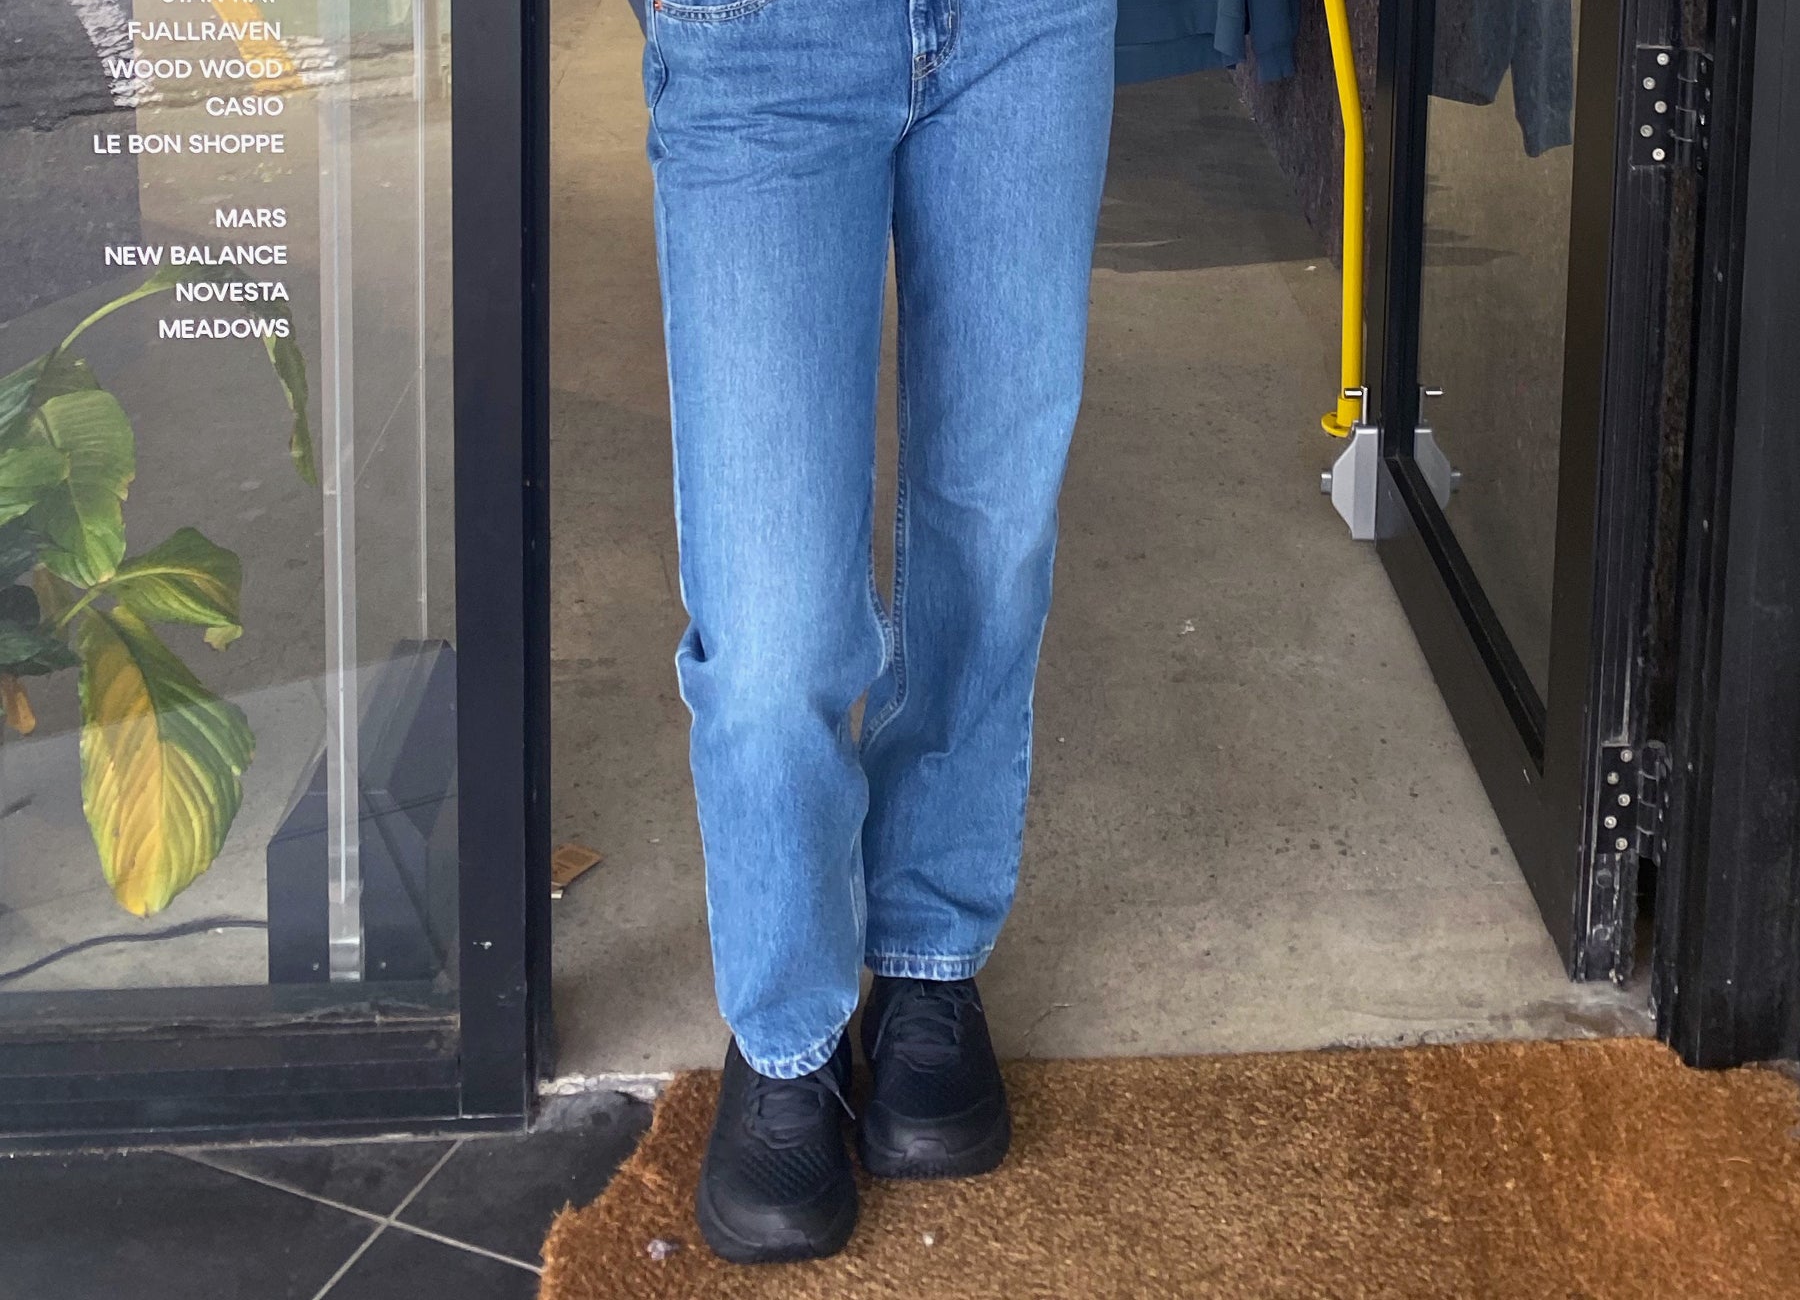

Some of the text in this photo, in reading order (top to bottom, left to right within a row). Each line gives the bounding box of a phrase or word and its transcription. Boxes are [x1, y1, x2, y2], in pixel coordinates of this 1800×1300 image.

[128, 21, 281, 41] FJALLRAVEN
[107, 59, 283, 79] WOOD WOOD
[205, 96, 284, 116] CASIO
[93, 134, 285, 154] LE BON SHOPPE
[215, 208, 287, 228] MARS
[104, 246, 288, 266] NEW BALANCE
[175, 282, 290, 302] NOVESTA
[158, 319, 290, 339] MEADOWS
